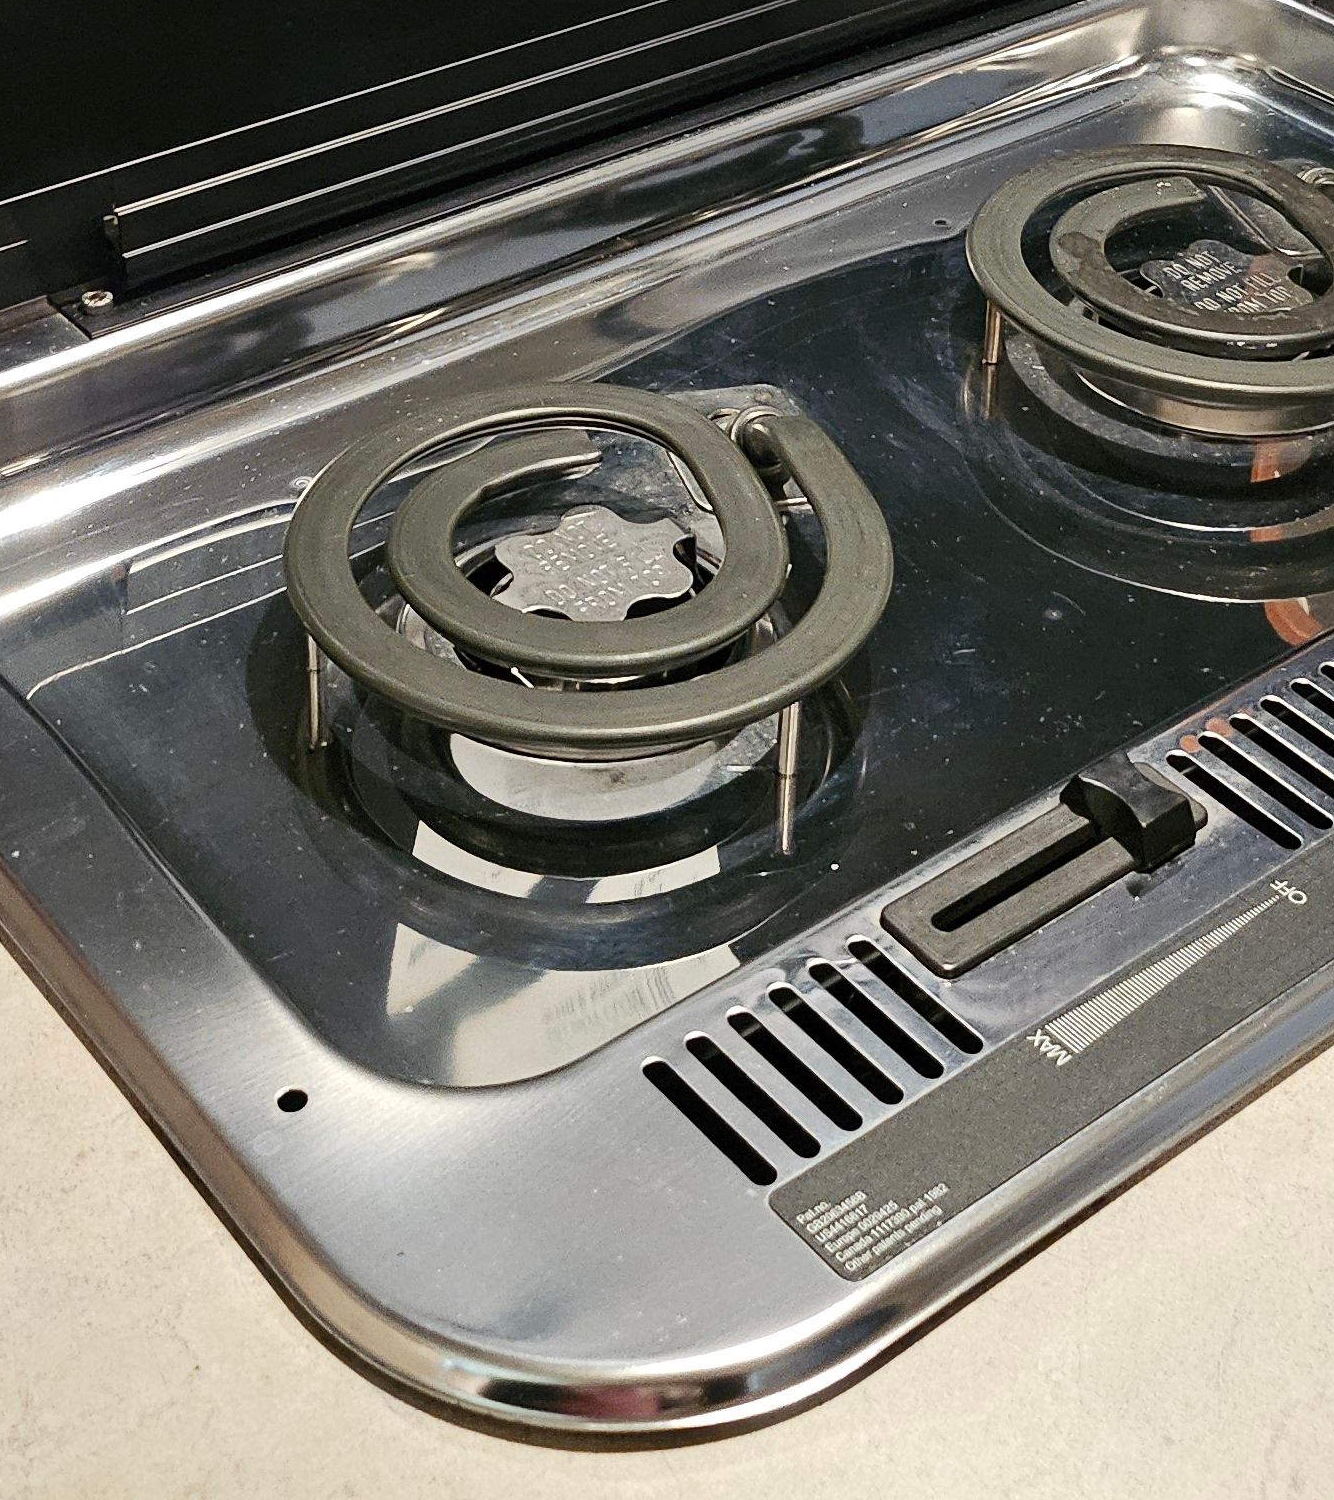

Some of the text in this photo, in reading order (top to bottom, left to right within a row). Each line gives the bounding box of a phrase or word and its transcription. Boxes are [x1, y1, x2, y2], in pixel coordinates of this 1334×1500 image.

[1163, 251, 1221, 280] DO NOT
[1181, 262, 1242, 292] REMOVE
[1216, 283, 1248, 303] NOT
[1269, 879, 1308, 905] OFF
[1027, 1028, 1072, 1067] MAX
[825, 1224, 860, 1253] Europe
[836, 1234, 874, 1263] Canada
[844, 1204, 943, 1272] Other patents pending
